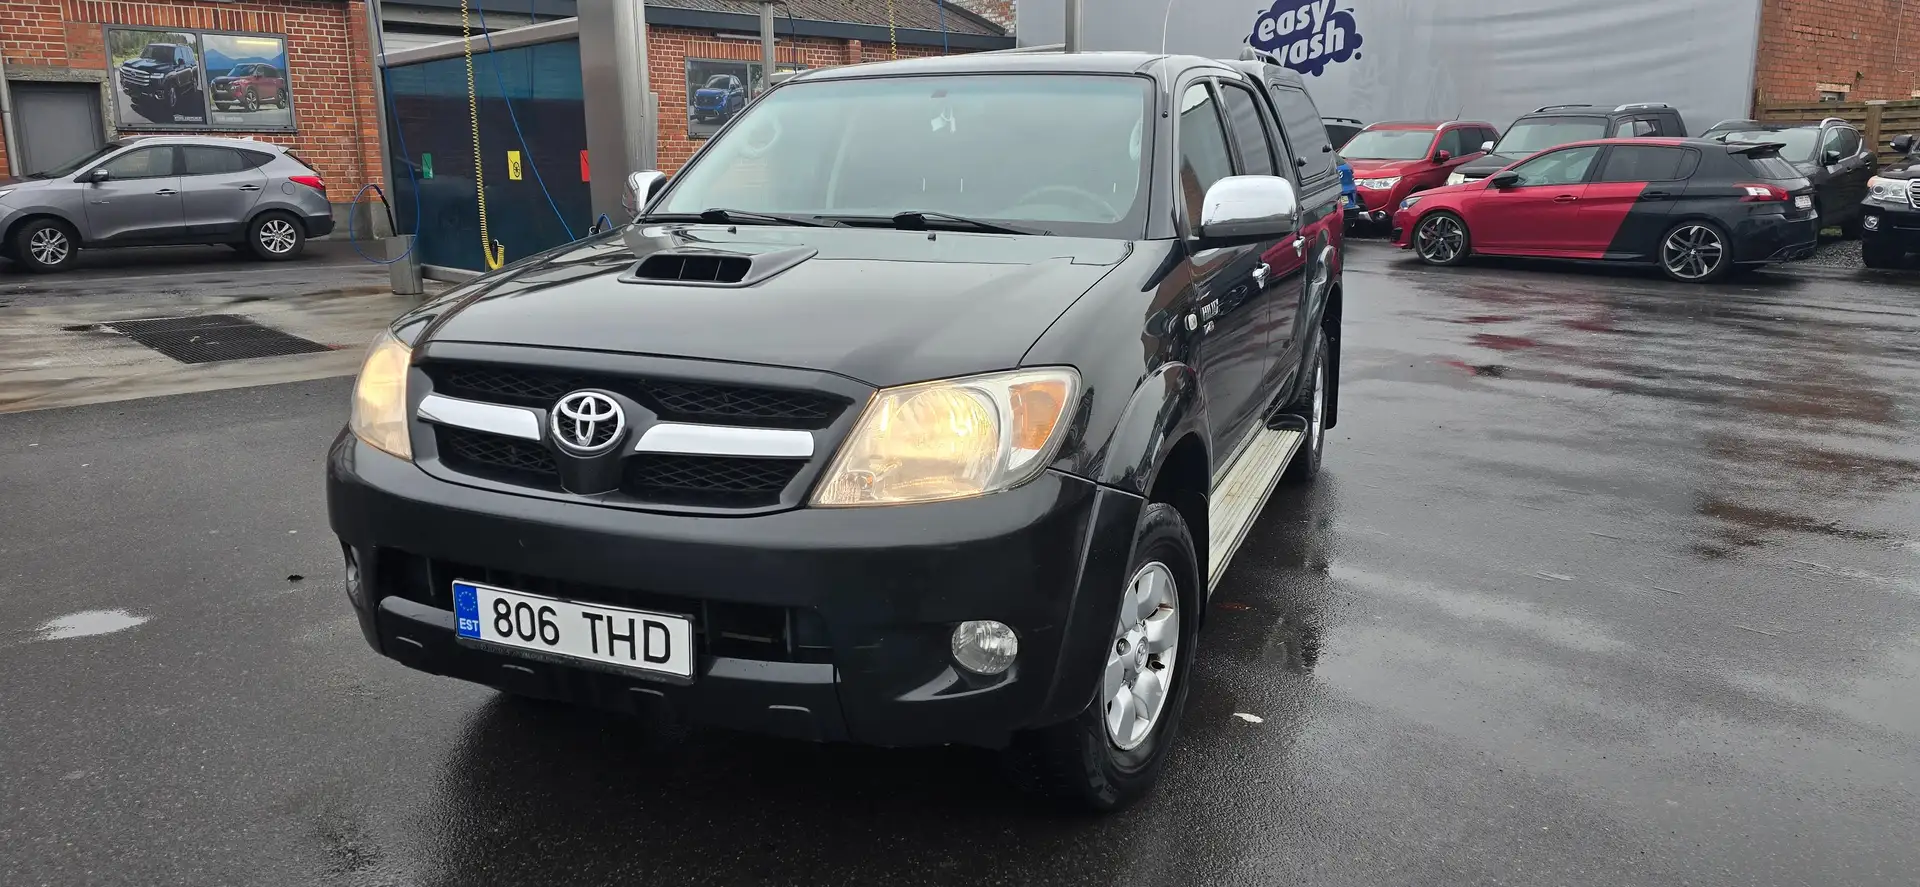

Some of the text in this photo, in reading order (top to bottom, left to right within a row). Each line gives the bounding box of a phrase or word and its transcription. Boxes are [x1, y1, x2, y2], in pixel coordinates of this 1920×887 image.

[1258, 0, 1328, 42] easy
[459, 618, 479, 632] EST
[494, 597, 560, 646] 806
[582, 611, 671, 664] THD
